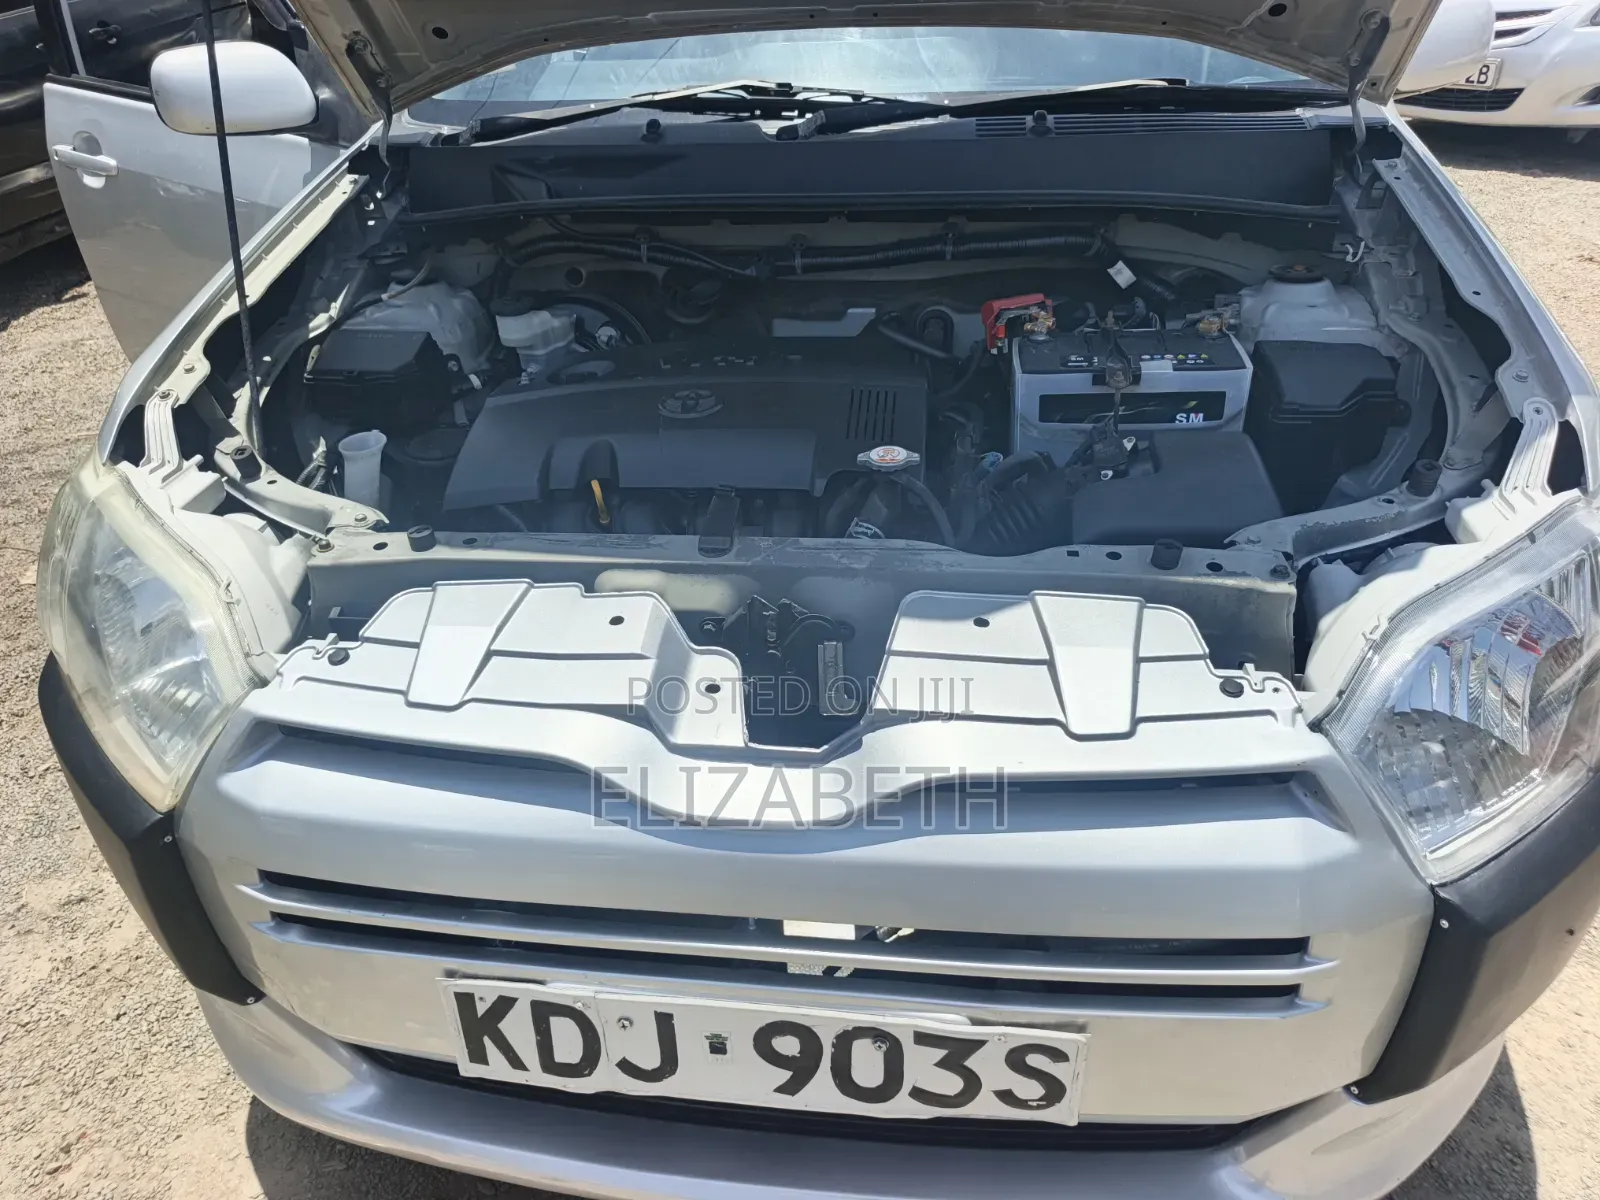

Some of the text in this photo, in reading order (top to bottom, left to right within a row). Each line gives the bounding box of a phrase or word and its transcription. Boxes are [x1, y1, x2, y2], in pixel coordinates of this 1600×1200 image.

[1175, 412, 1204, 425] SM
[453, 991, 1070, 1110] KDJ 903S
